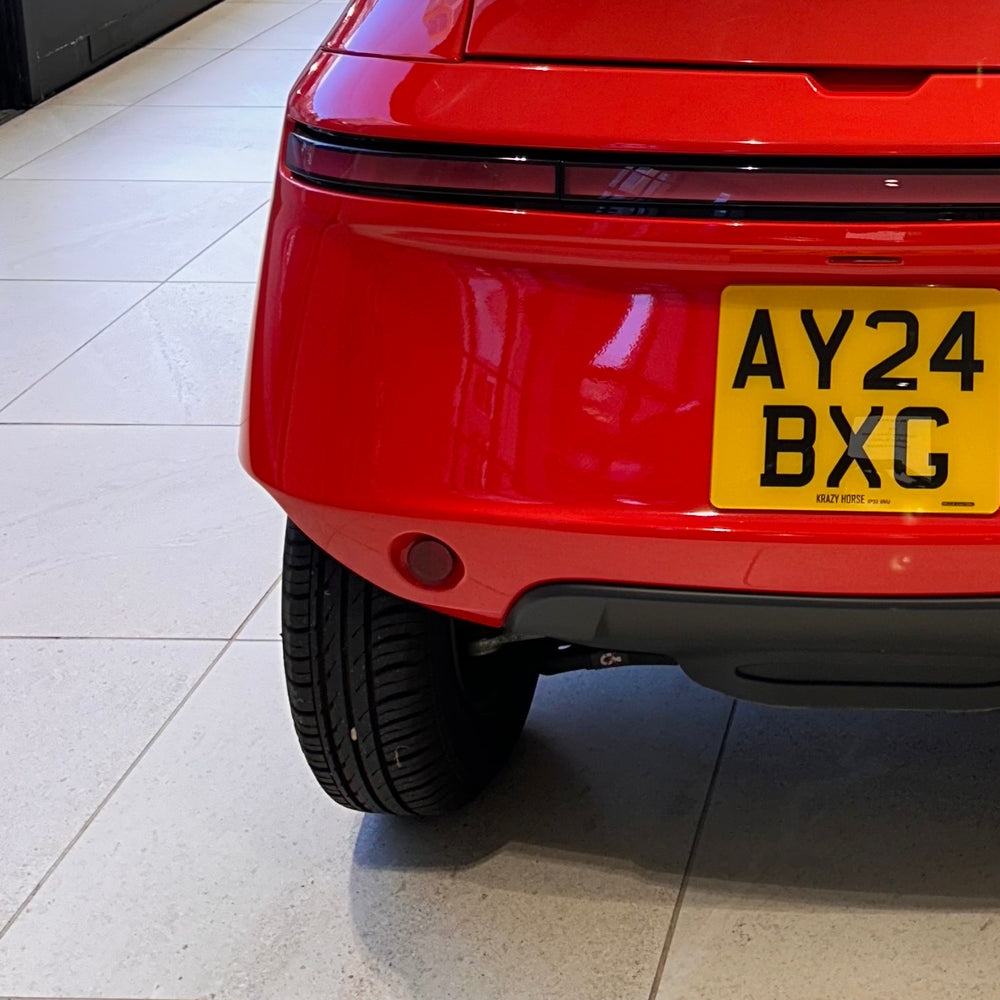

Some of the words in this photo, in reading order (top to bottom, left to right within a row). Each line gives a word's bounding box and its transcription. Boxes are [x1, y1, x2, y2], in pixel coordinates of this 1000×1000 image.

[732, 309, 984, 392] AY24
[760, 405, 950, 489] BXG
[816, 493, 839, 504] KRAZY
[841, 494, 865, 504] HORSE
